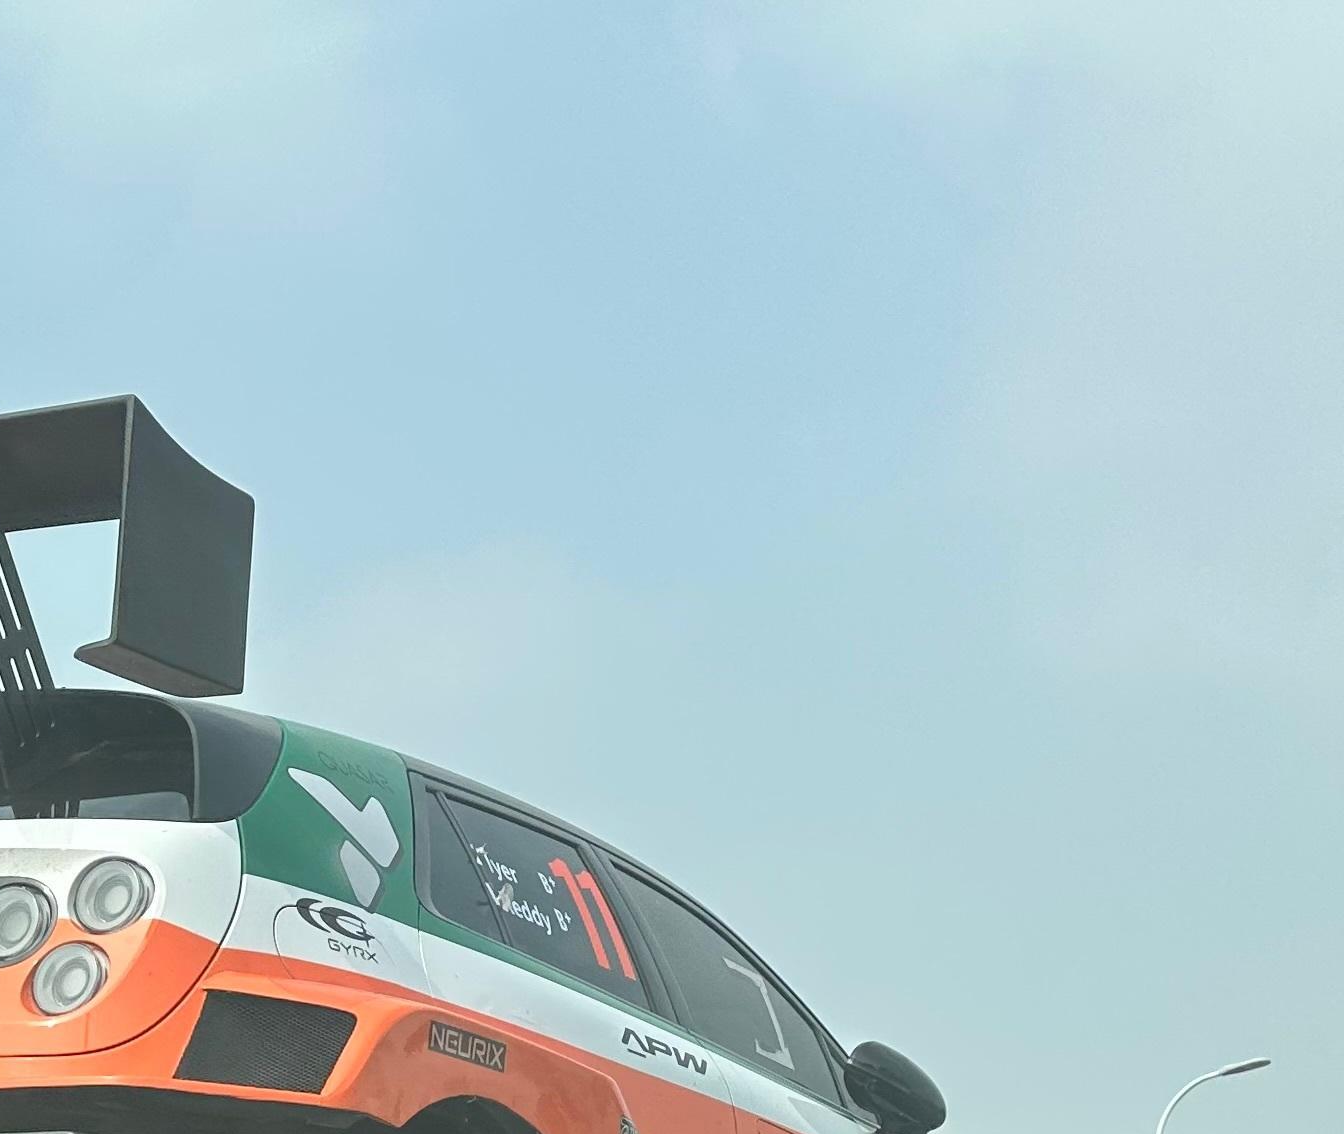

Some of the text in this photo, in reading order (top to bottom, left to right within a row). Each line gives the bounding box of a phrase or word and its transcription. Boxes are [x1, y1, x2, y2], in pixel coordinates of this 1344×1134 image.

[547, 857, 637, 981] 11
[327, 937, 379, 964] GYRX
[429, 1024, 505, 1071] NEURIX
